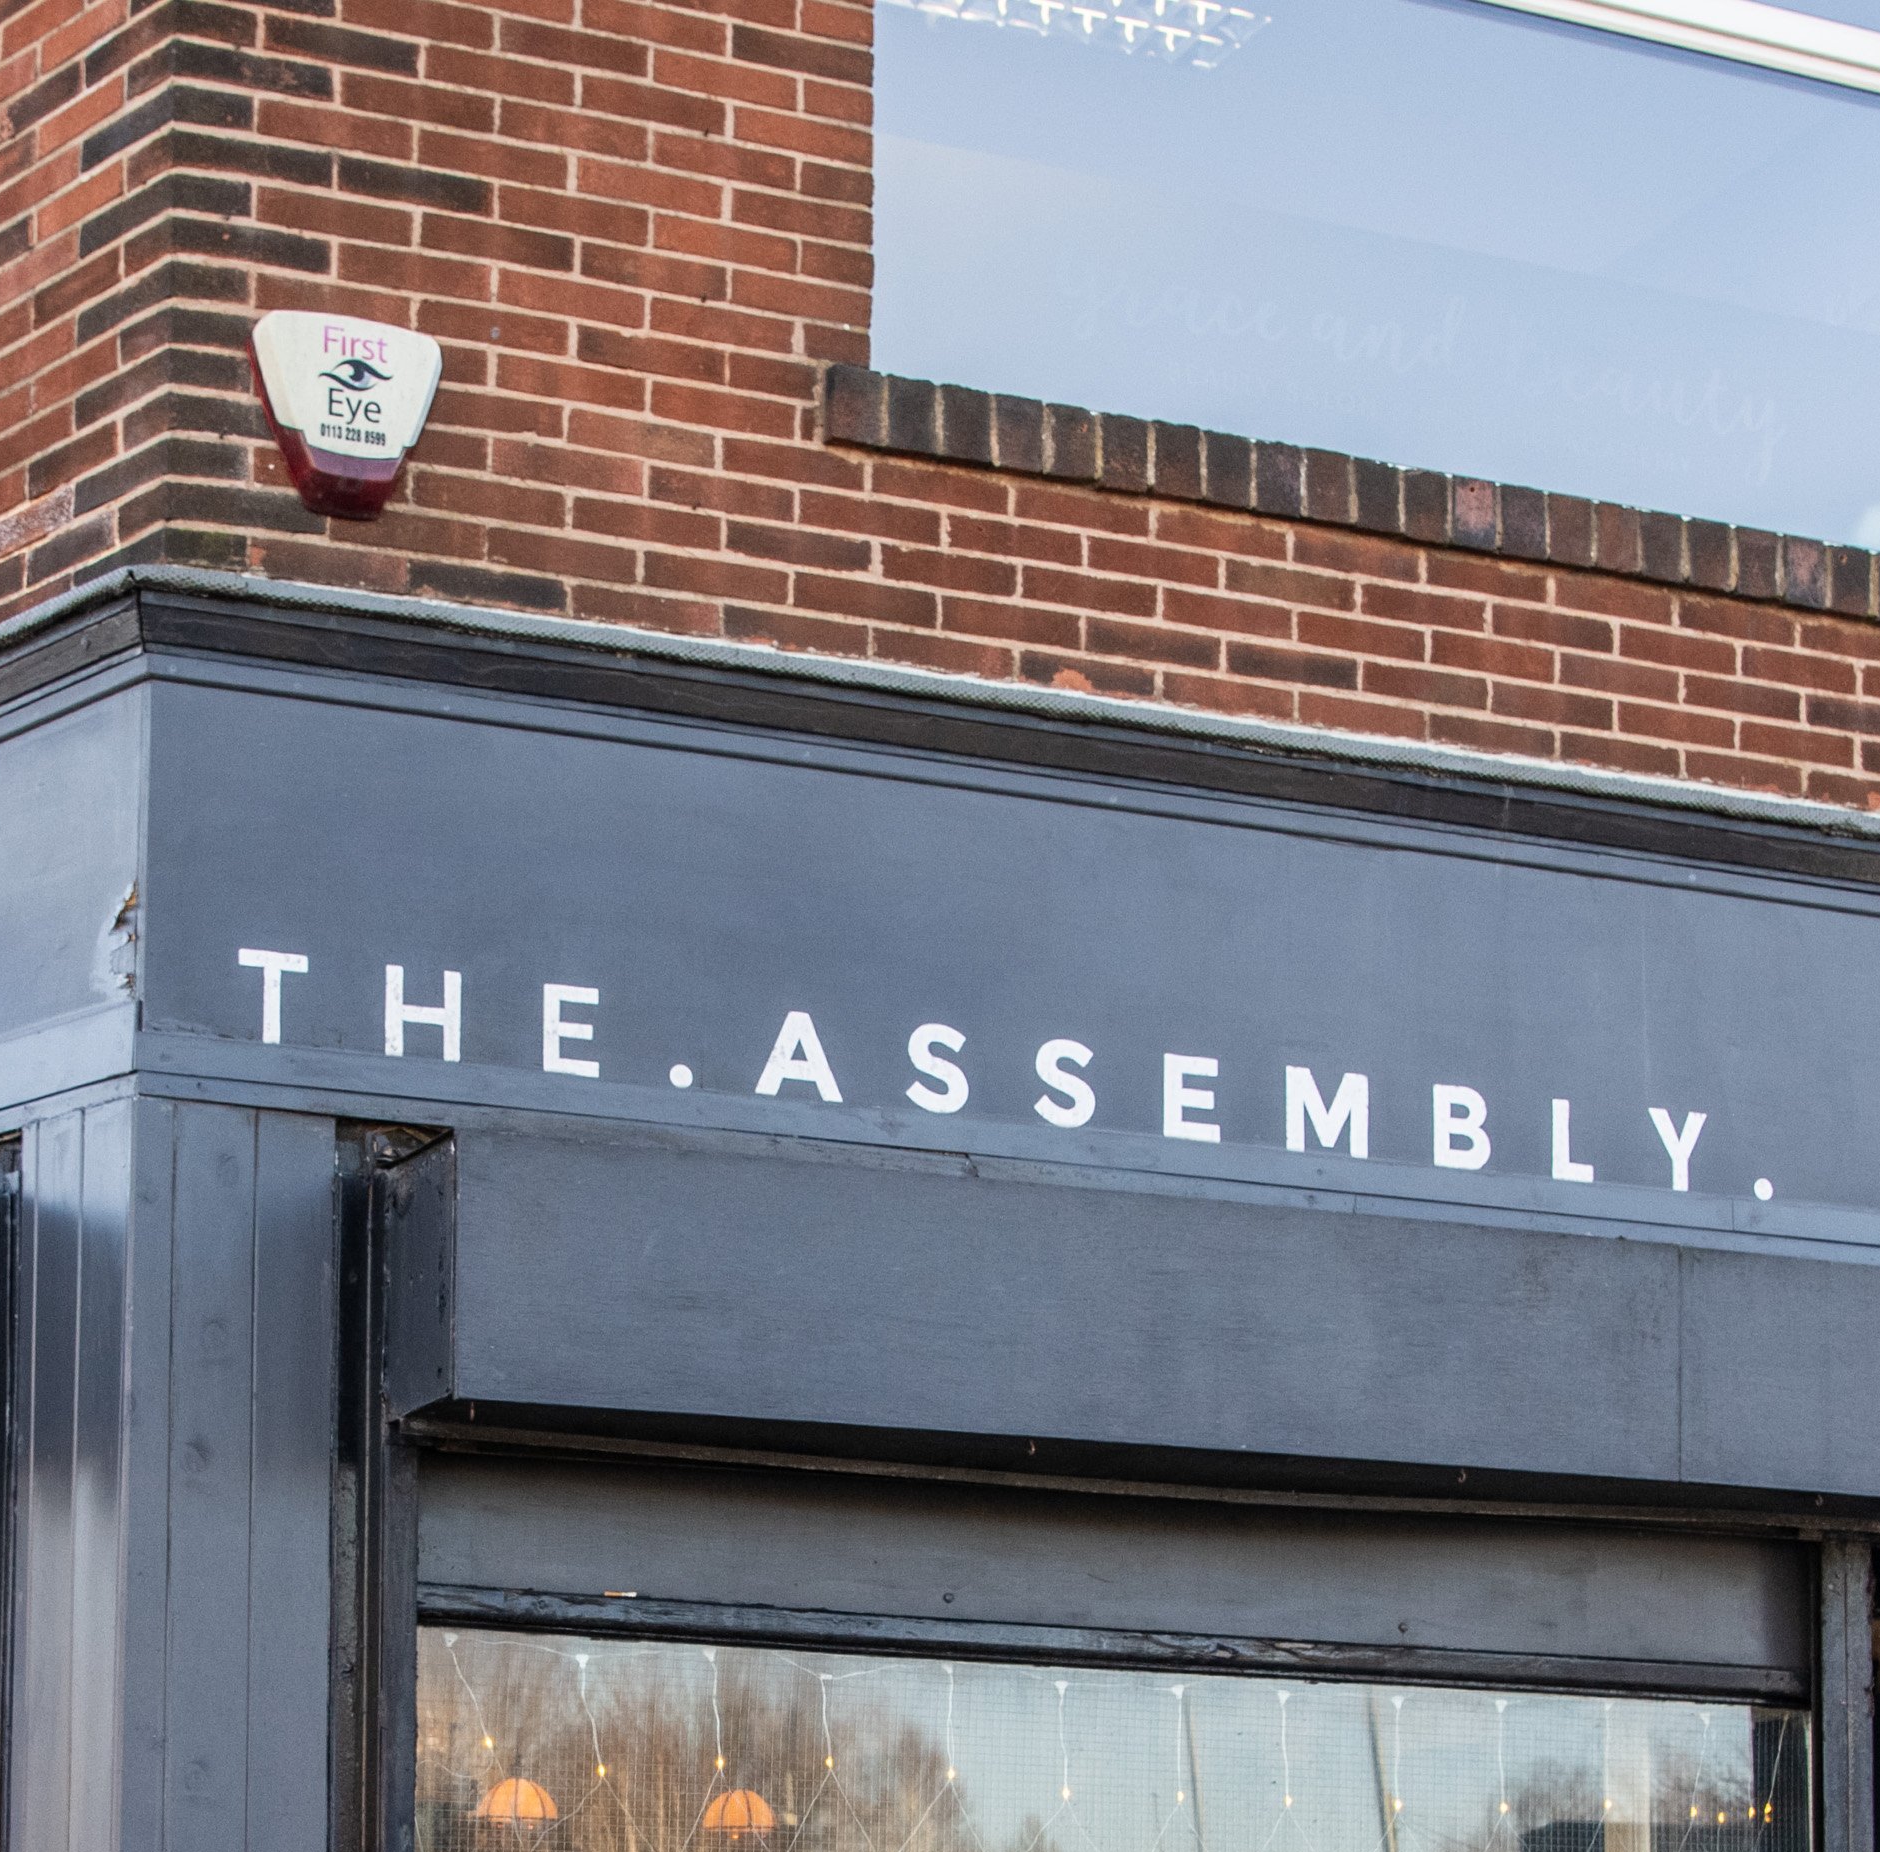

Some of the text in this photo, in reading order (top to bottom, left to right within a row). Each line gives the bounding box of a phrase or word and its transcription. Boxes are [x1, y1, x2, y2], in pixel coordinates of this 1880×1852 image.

[322, 325, 389, 365] First
[328, 387, 381, 425] Eye
[320, 424, 344, 440] 0113
